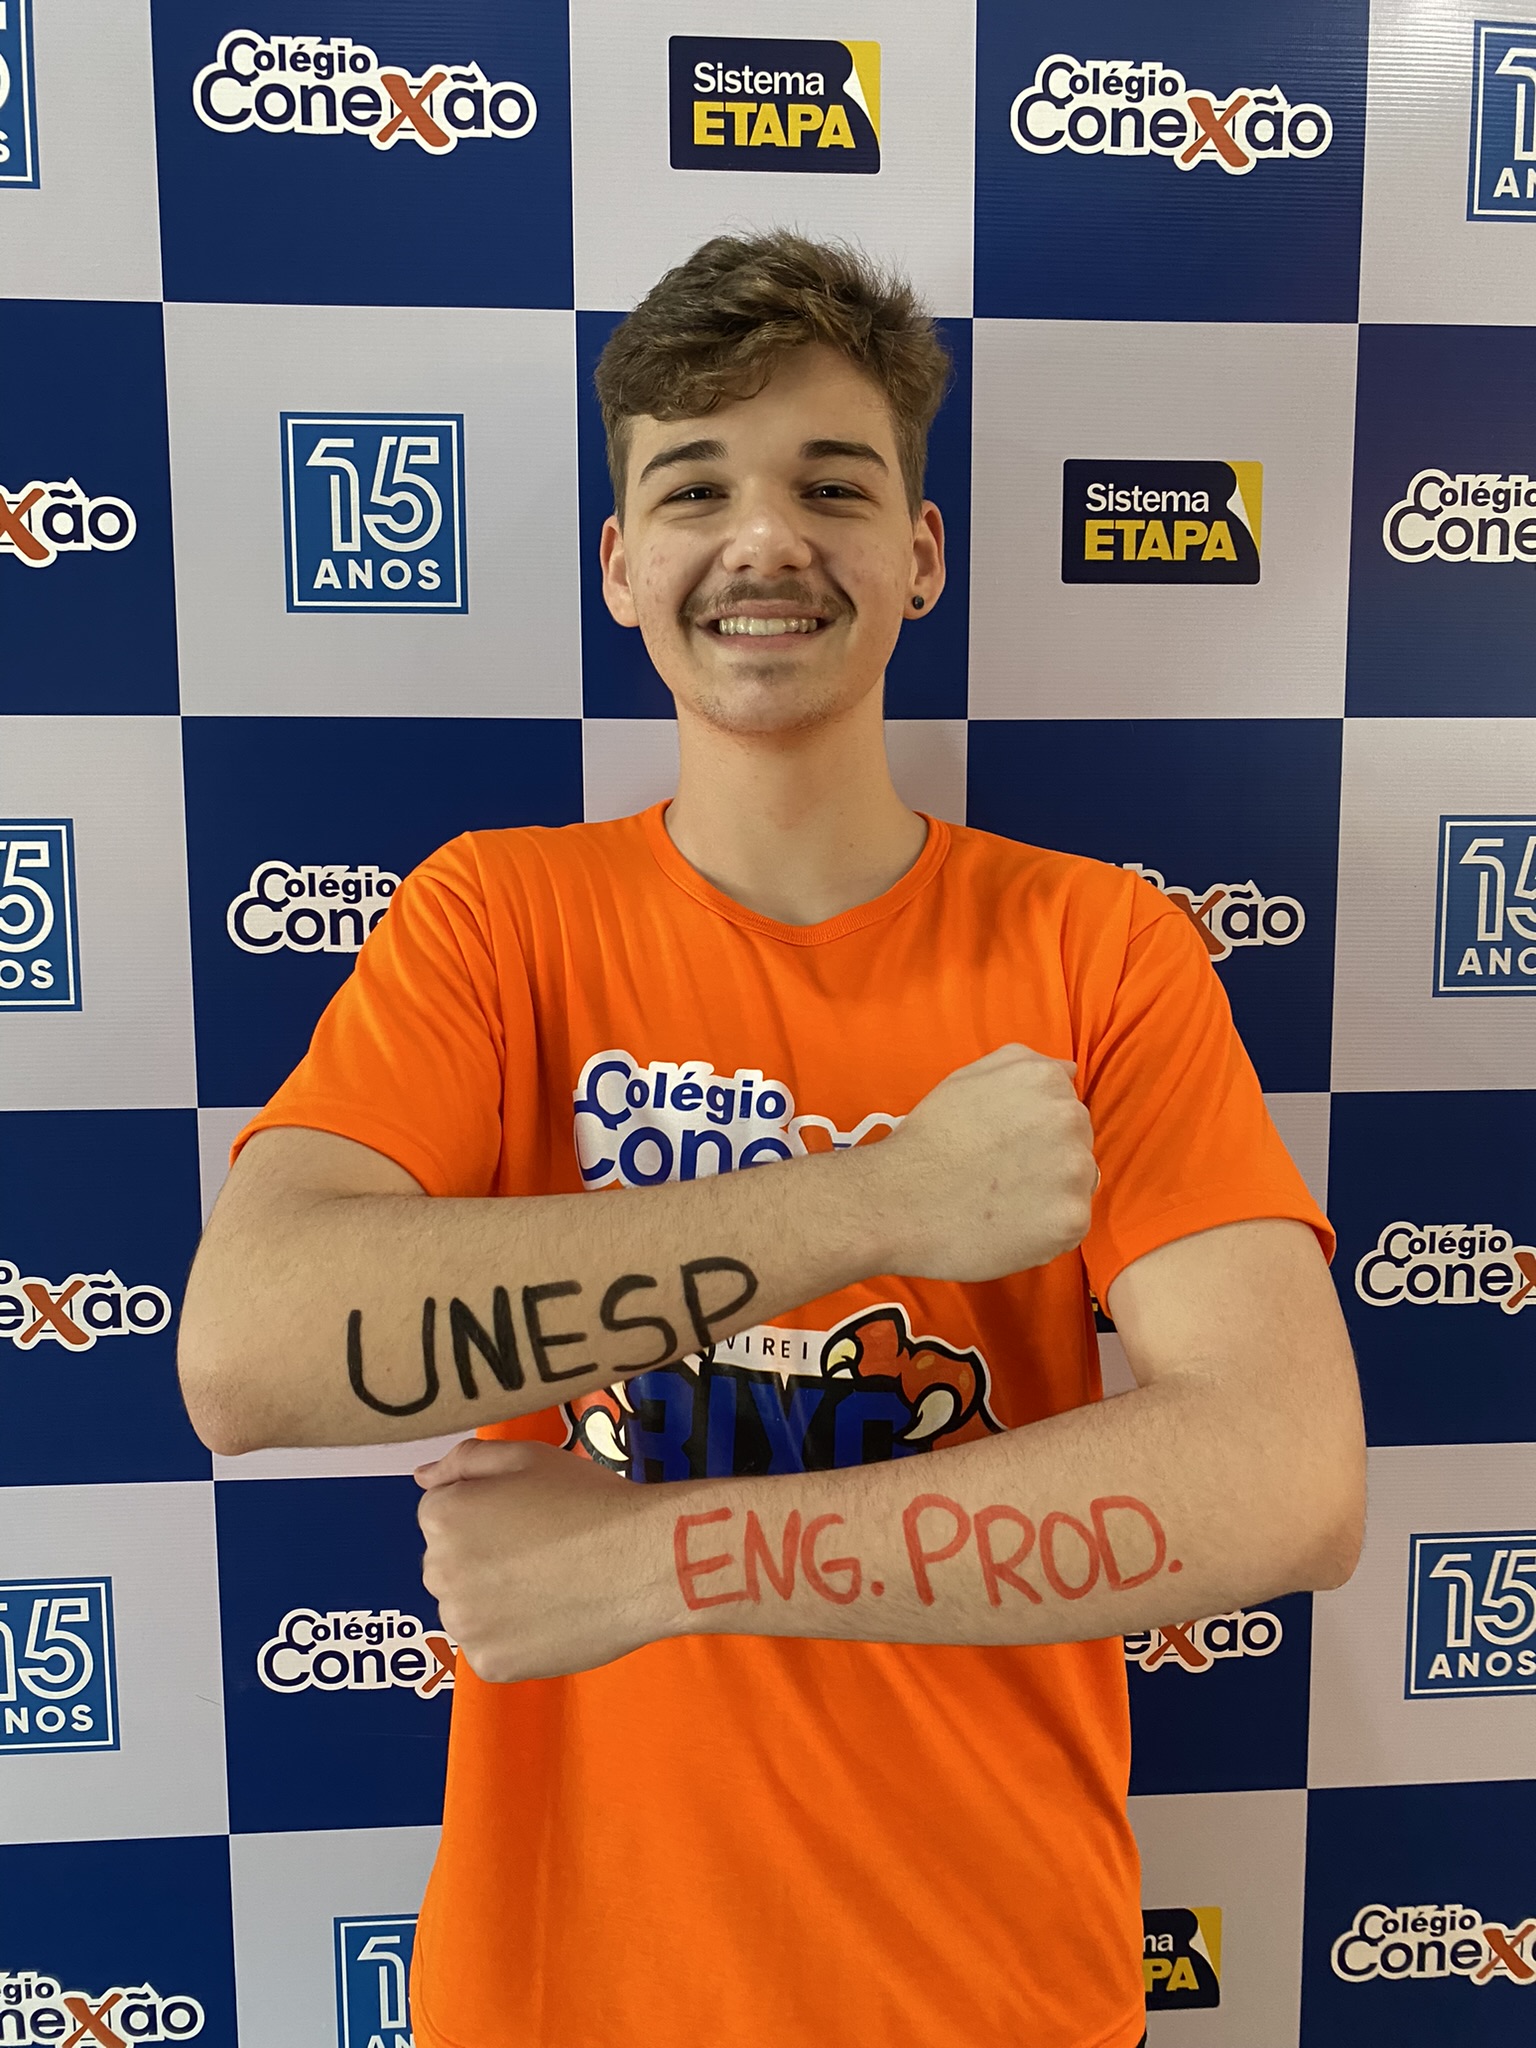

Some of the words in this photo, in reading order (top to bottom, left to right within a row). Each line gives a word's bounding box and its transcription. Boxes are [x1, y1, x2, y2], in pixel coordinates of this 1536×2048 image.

[225, 37, 371, 80] Colégio
[693, 62, 825, 96] Sistema
[1042, 61, 1179, 102] Colégio
[693, 101, 856, 149] ETAPA
[306, 436, 443, 552] 15
[1085, 483, 1210, 513] Sistema
[1084, 519, 1238, 561] ETAPA
[313, 558, 442, 591] ANOS
[257, 868, 397, 907] Colégio
[586, 1061, 787, 1125] Colégio
[1384, 1228, 1507, 1263] Colégio
[347, 1256, 760, 1417] UNESP
[726, 1336, 809, 1359] VIREI
[673, 1507, 886, 1610] ENG.
[902, 1493, 1185, 1608] PROD.
[1429, 1550, 1536, 1647] 15
[286, 1615, 417, 1650] Colégio
[1428, 1650, 1536, 1680] ANOS
[1359, 1910, 1476, 1942] Colégio
